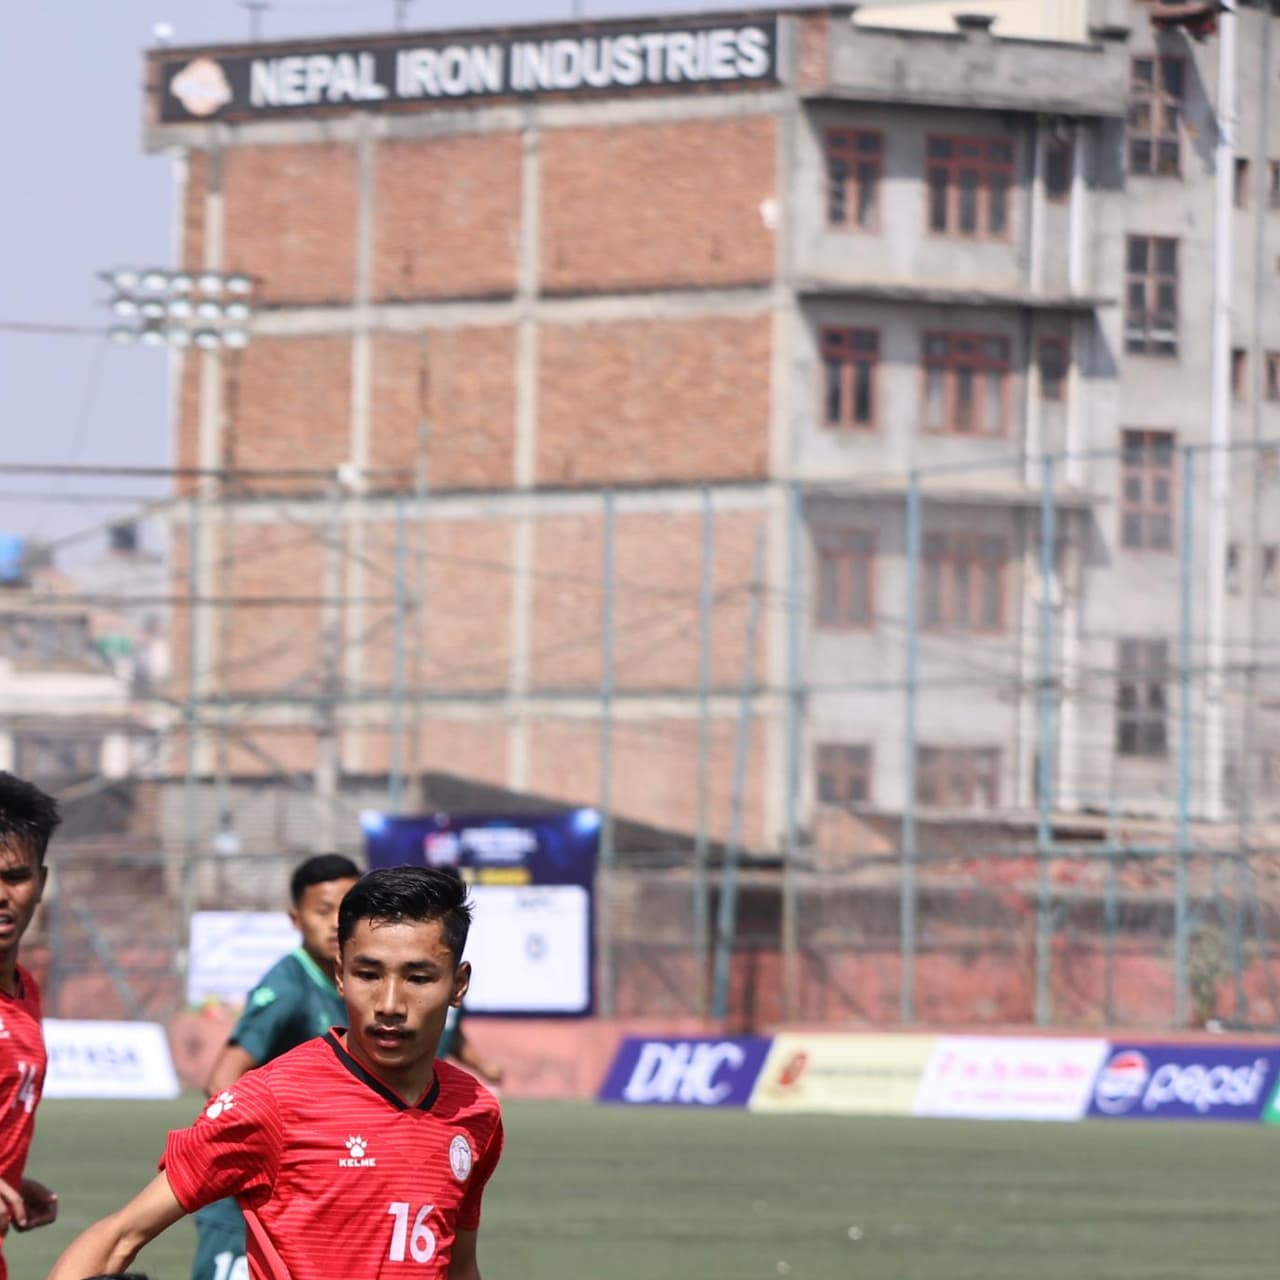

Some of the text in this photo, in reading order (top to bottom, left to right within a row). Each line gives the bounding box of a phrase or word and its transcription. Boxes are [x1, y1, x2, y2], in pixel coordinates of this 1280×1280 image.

[250, 30, 768, 107] NEPAL IRON INDUSTRIES
[623, 1041, 746, 1104] DHC
[1141, 1057, 1269, 1113] pepsi
[338, 1158, 377, 1168] KELME
[388, 1202, 436, 1263] 16
